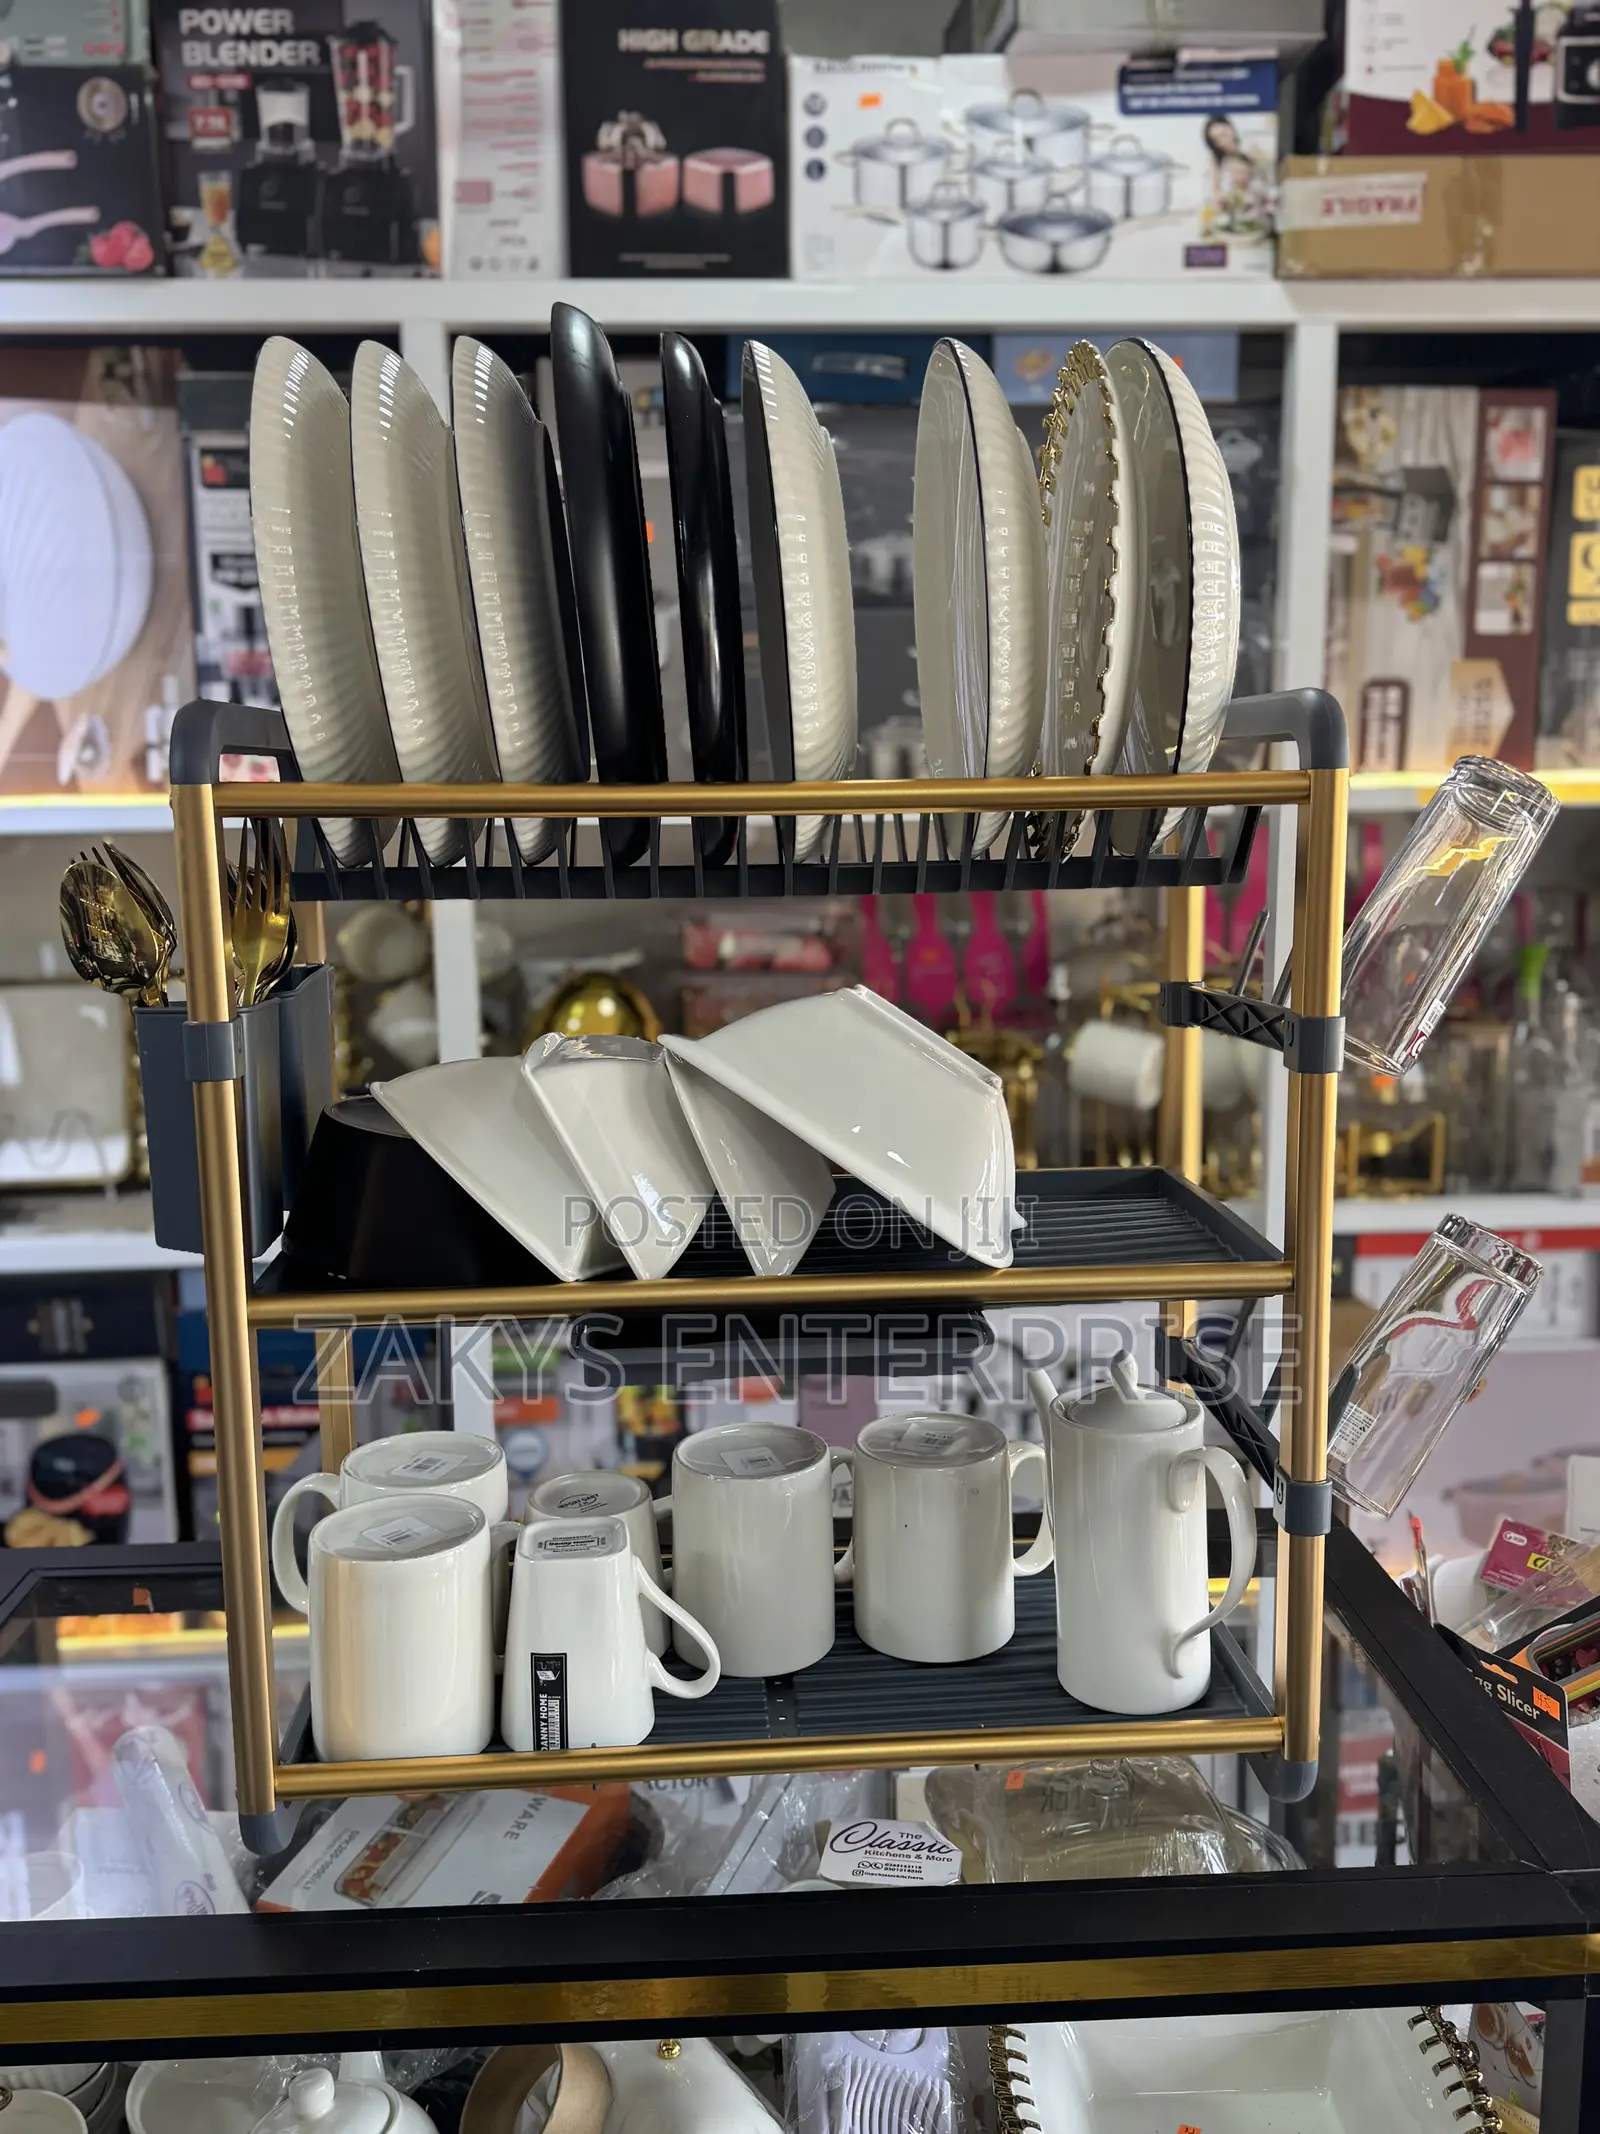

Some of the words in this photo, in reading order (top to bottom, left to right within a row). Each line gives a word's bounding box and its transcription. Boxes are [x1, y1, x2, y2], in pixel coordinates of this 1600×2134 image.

[178, 7, 295, 36] POWER
[181, 39, 321, 67] BLENDER
[618, 28, 678, 51] HIGH
[682, 30, 770, 54] GRADE
[539, 1693, 548, 1719] HOME
[1496, 1683, 1541, 1720] Slicer
[539, 1720, 549, 1751] DANNY
[503, 1797, 548, 1841] WARE
[829, 1821, 957, 1854] Classic
[899, 1832, 923, 1840] The
[863, 1849, 912, 1859] Kitchens
[925, 1854, 953, 1863] More
